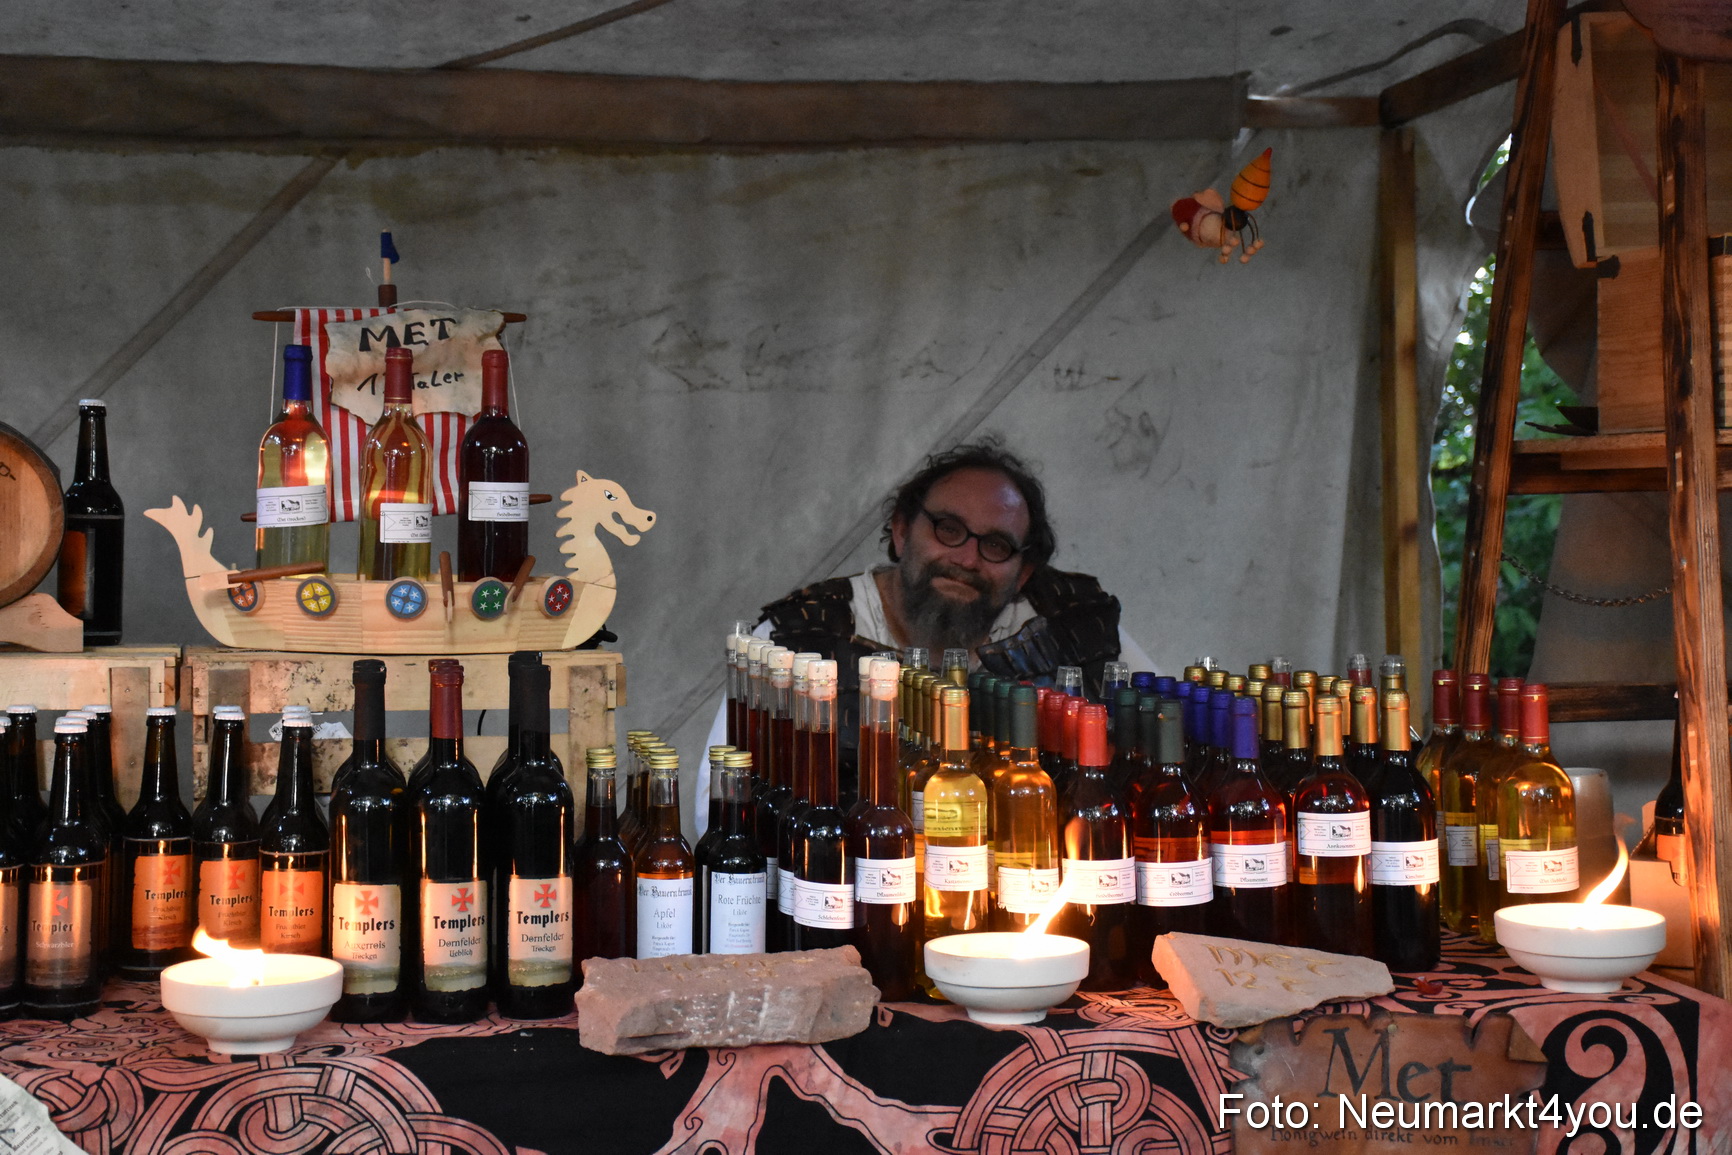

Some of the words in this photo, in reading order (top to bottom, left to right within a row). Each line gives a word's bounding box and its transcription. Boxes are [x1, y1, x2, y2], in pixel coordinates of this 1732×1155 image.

[359, 318, 457, 352] MET
[357, 373, 385, 395] 1
[145, 889, 188, 903] Templers
[209, 894, 253, 908] Templers
[717, 894, 735, 905] Rote
[736, 894, 762, 905] Früchte
[517, 910, 569, 928] Templers
[653, 908, 676, 920] Apfel
[31, 920, 74, 935] Tepler
[338, 916, 395, 935] Templers
[433, 914, 486, 932] Templers
[656, 921, 672, 929] Likör
[438, 936, 482, 948] Dornfelder
[521, 931, 564, 944] Dornfelder
[1316, 1027, 1472, 1105] Met
[1364, 1127, 1413, 1143] direkt
[1423, 1134, 1458, 1146] vom
